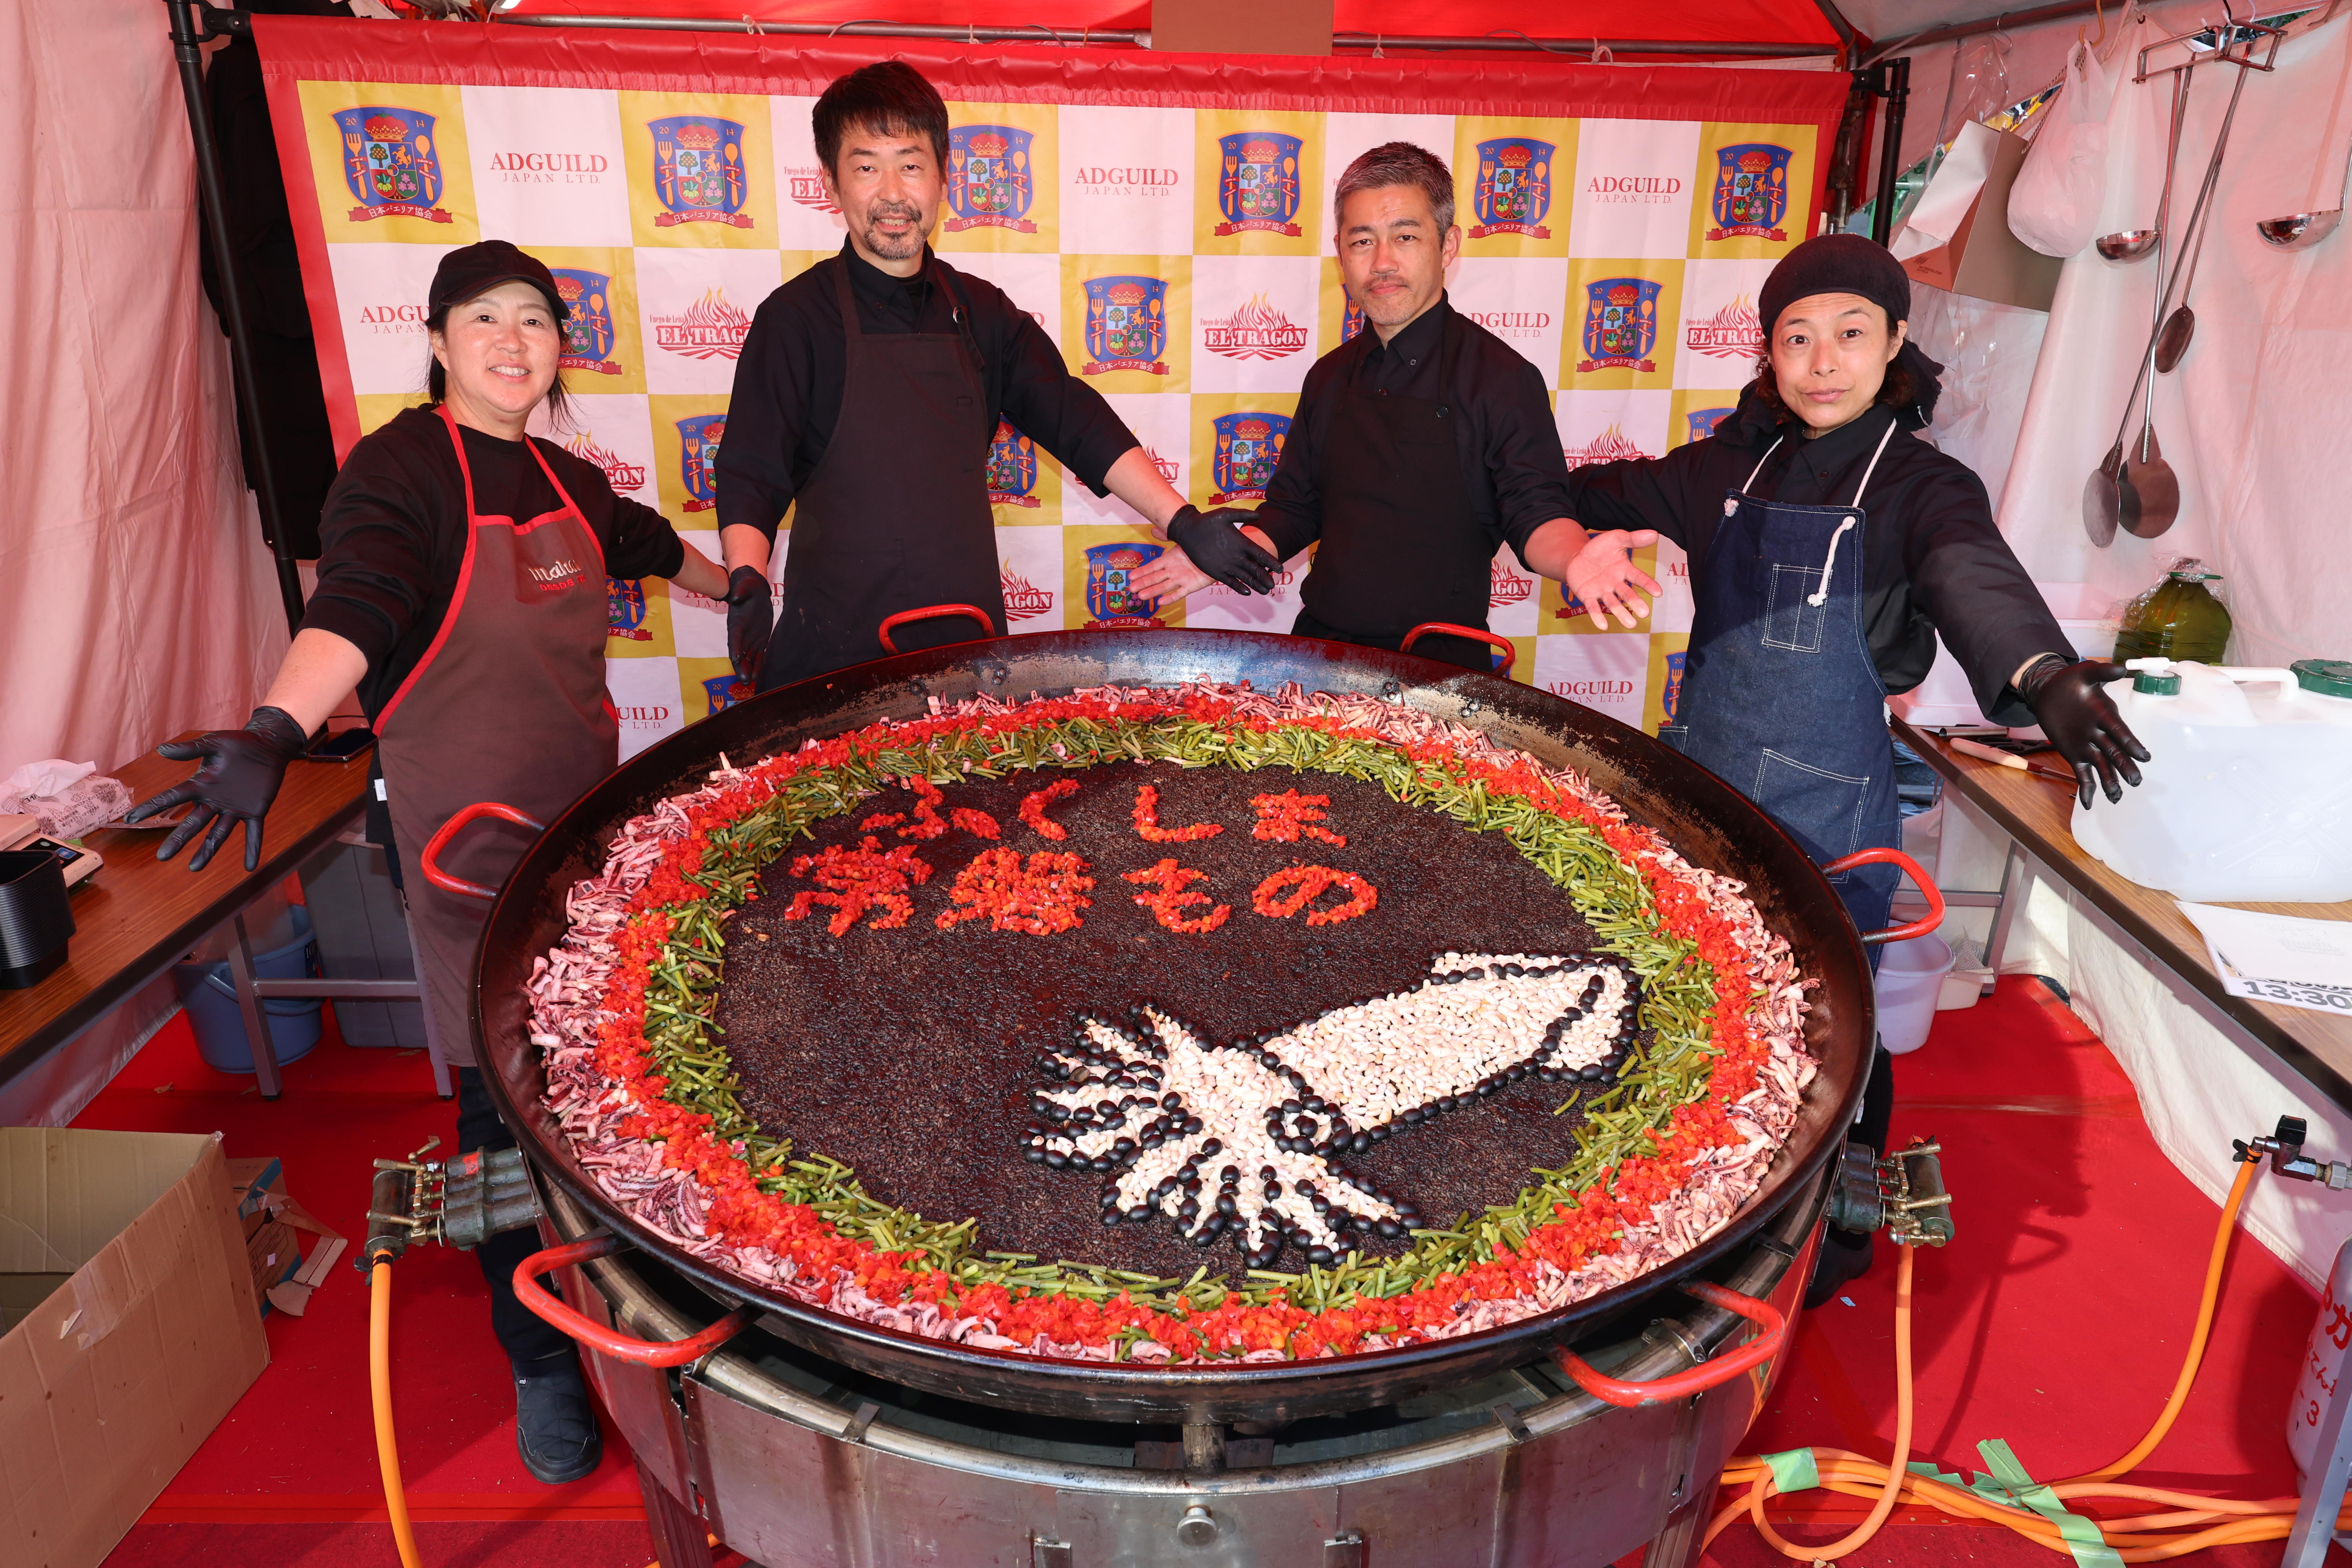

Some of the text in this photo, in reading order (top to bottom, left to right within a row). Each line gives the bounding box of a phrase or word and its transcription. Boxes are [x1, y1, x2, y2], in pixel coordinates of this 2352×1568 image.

[490, 152, 608, 172] ADGUILD
[503, 173, 601, 183] JAPAN LTD.
[784, 166, 799, 176] Fuego
[808, 167, 818, 175] Leña
[1074, 167, 1178, 185] ADGUILD
[793, 180, 819, 197] EL
[1085, 187, 1170, 196] JAPAN LTD.
[1587, 177, 1680, 193] ADGUILD
[1596, 194, 1671, 203] JAPAN LTD.
[360, 305, 430, 323] ADGU
[650, 315, 664, 324] Fuego
[1470, 313, 1550, 327] DGUILD
[374, 324, 425, 334] JAPAN
[1200, 318, 1213, 327] Fuego
[659, 328, 751, 343] EL TRAG
[1208, 325, 1306, 346] EL TRAGÓN
[1689, 330, 1762, 344] EL TRAG
[557, 359, 603, 372] パエリア協会
[604, 464, 643, 483] GÓN
[540, 579, 574, 591] DESDE
[1005, 588, 1051, 608] AGÓN
[1547, 681, 1633, 695] ADGUILD
[615, 707, 668, 720] UILD
[2243, 981, 2352, 1009] 13:30
